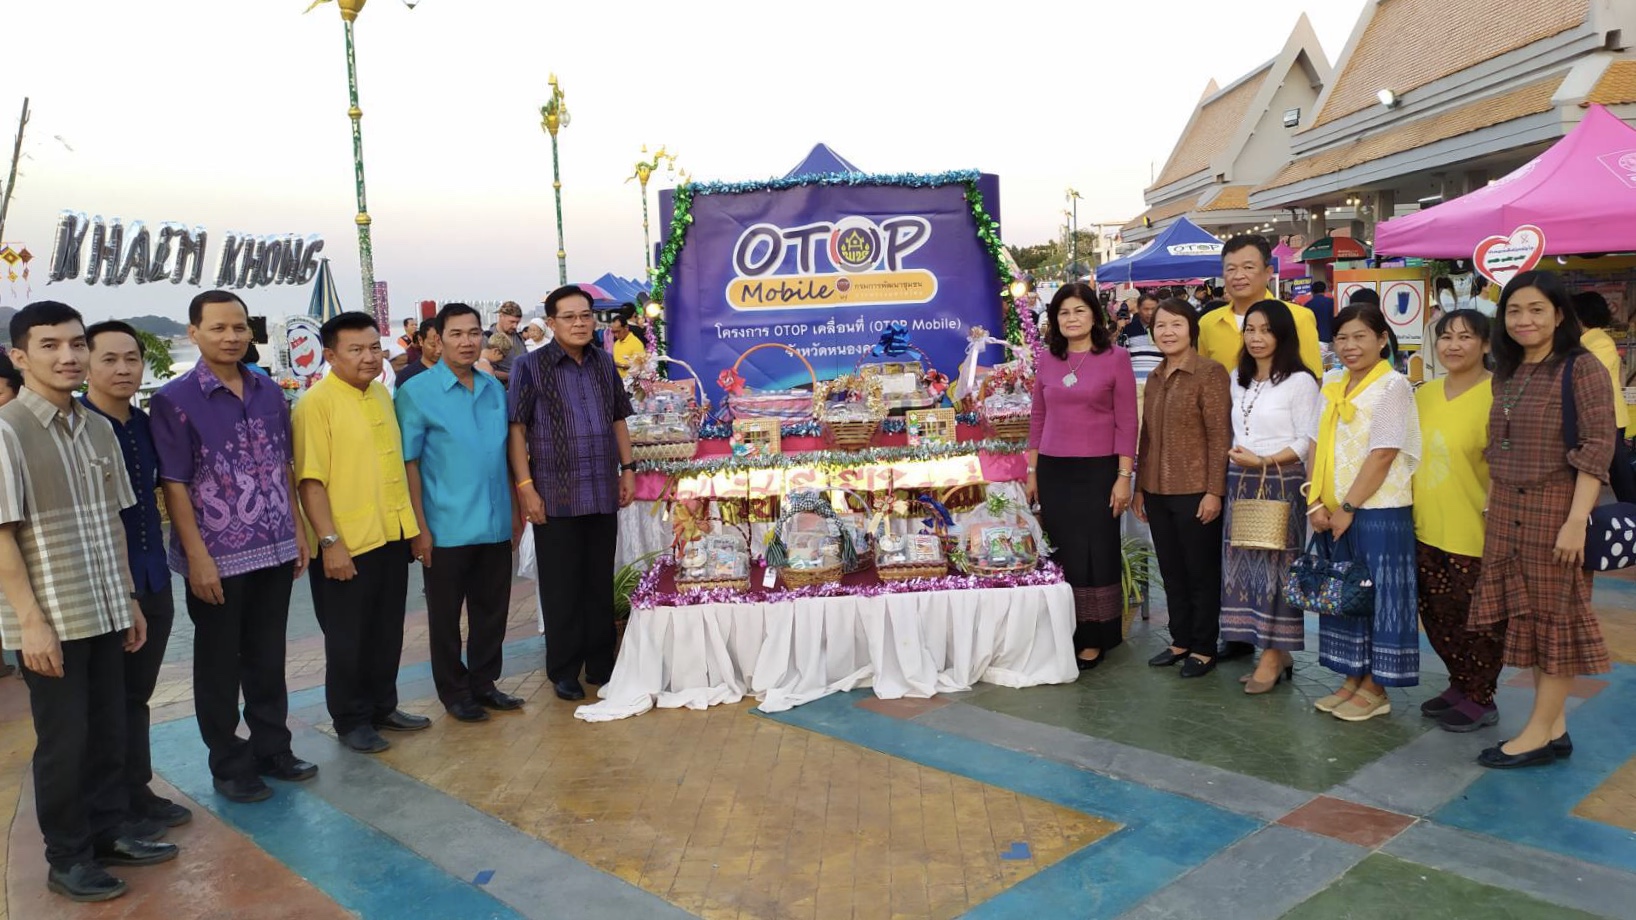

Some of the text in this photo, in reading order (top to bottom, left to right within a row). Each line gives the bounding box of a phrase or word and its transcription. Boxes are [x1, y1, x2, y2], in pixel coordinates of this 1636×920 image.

[213, 229, 325, 289] KHONG
[735, 217, 928, 276] OTOP
[741, 280, 834, 303] Mobile
[715, 322, 769, 340] โครงการ
[774, 323, 808, 337] OTOP
[813, 315, 865, 336] เคลื่อนที่
[912, 317, 962, 331] Mobile)
